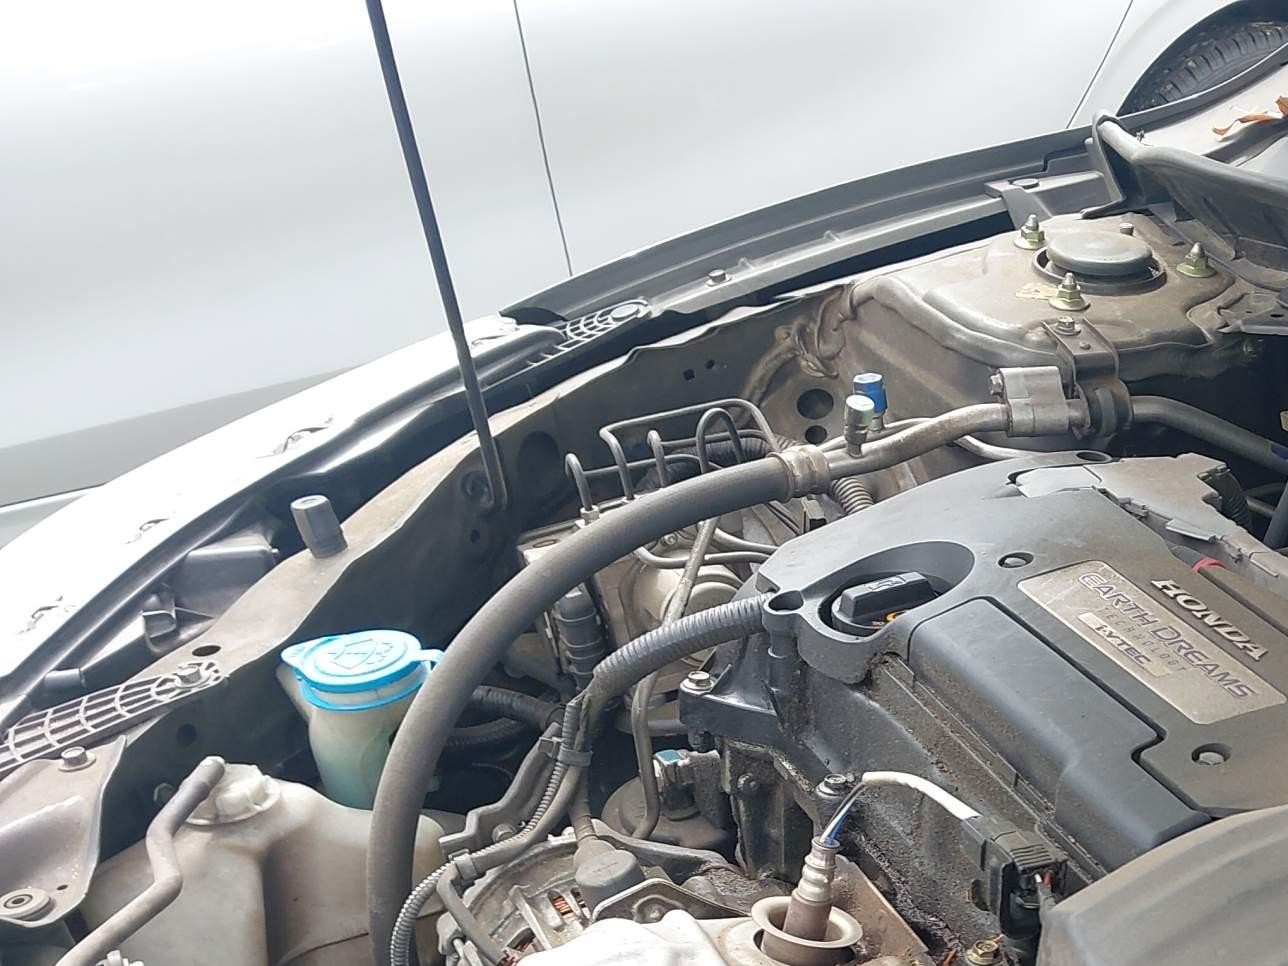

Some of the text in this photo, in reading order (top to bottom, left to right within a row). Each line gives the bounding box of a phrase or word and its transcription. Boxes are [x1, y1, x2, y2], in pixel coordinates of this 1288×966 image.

[1078, 571, 1260, 699] EARTH DREAMS
[1150, 579, 1270, 662] HONDA
